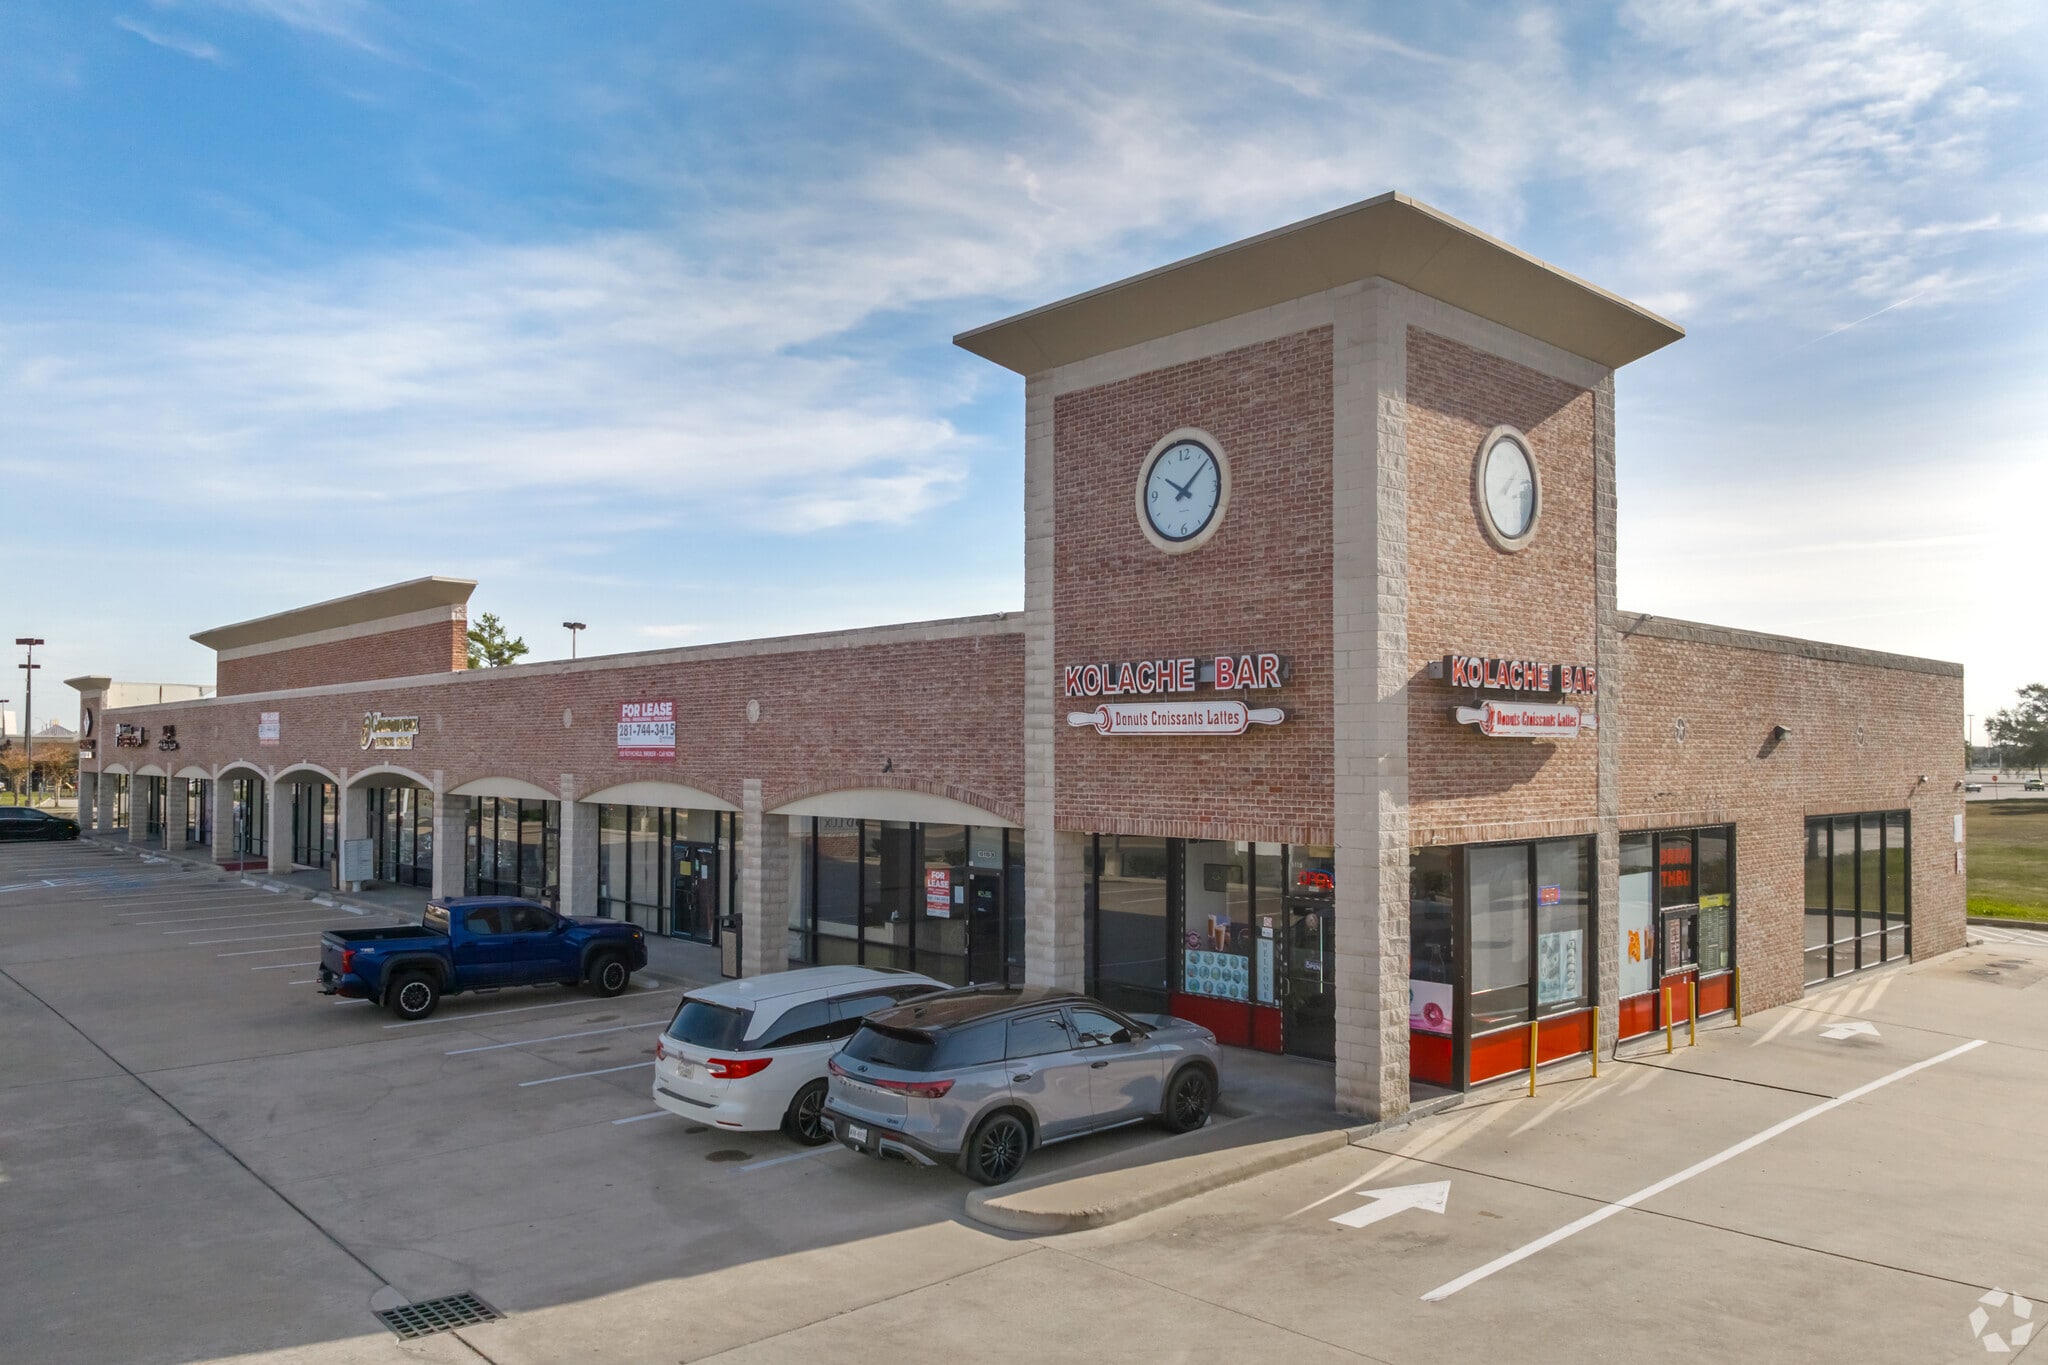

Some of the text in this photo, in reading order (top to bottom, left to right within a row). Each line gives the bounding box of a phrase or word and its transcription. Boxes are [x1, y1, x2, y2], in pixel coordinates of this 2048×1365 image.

[1179, 448, 1191, 461] 12
[1211, 480, 1217, 492] 3
[1151, 490, 1159, 503] 9
[1181, 523, 1187, 535] 6
[1065, 653, 1281, 697] KOLACHE BAR
[1452, 655, 1597, 695] KOLACHE BAR
[622, 702, 673, 717] FOR LEASE
[1115, 709, 1240, 726] Donuts Croissants Lattes
[1497, 710, 1577, 727] Donuts Croissants Lattes
[619, 723, 675, 737] 281-744-3415
[931, 871, 945, 879] FOR
[927, 879, 949, 888] LEASE
